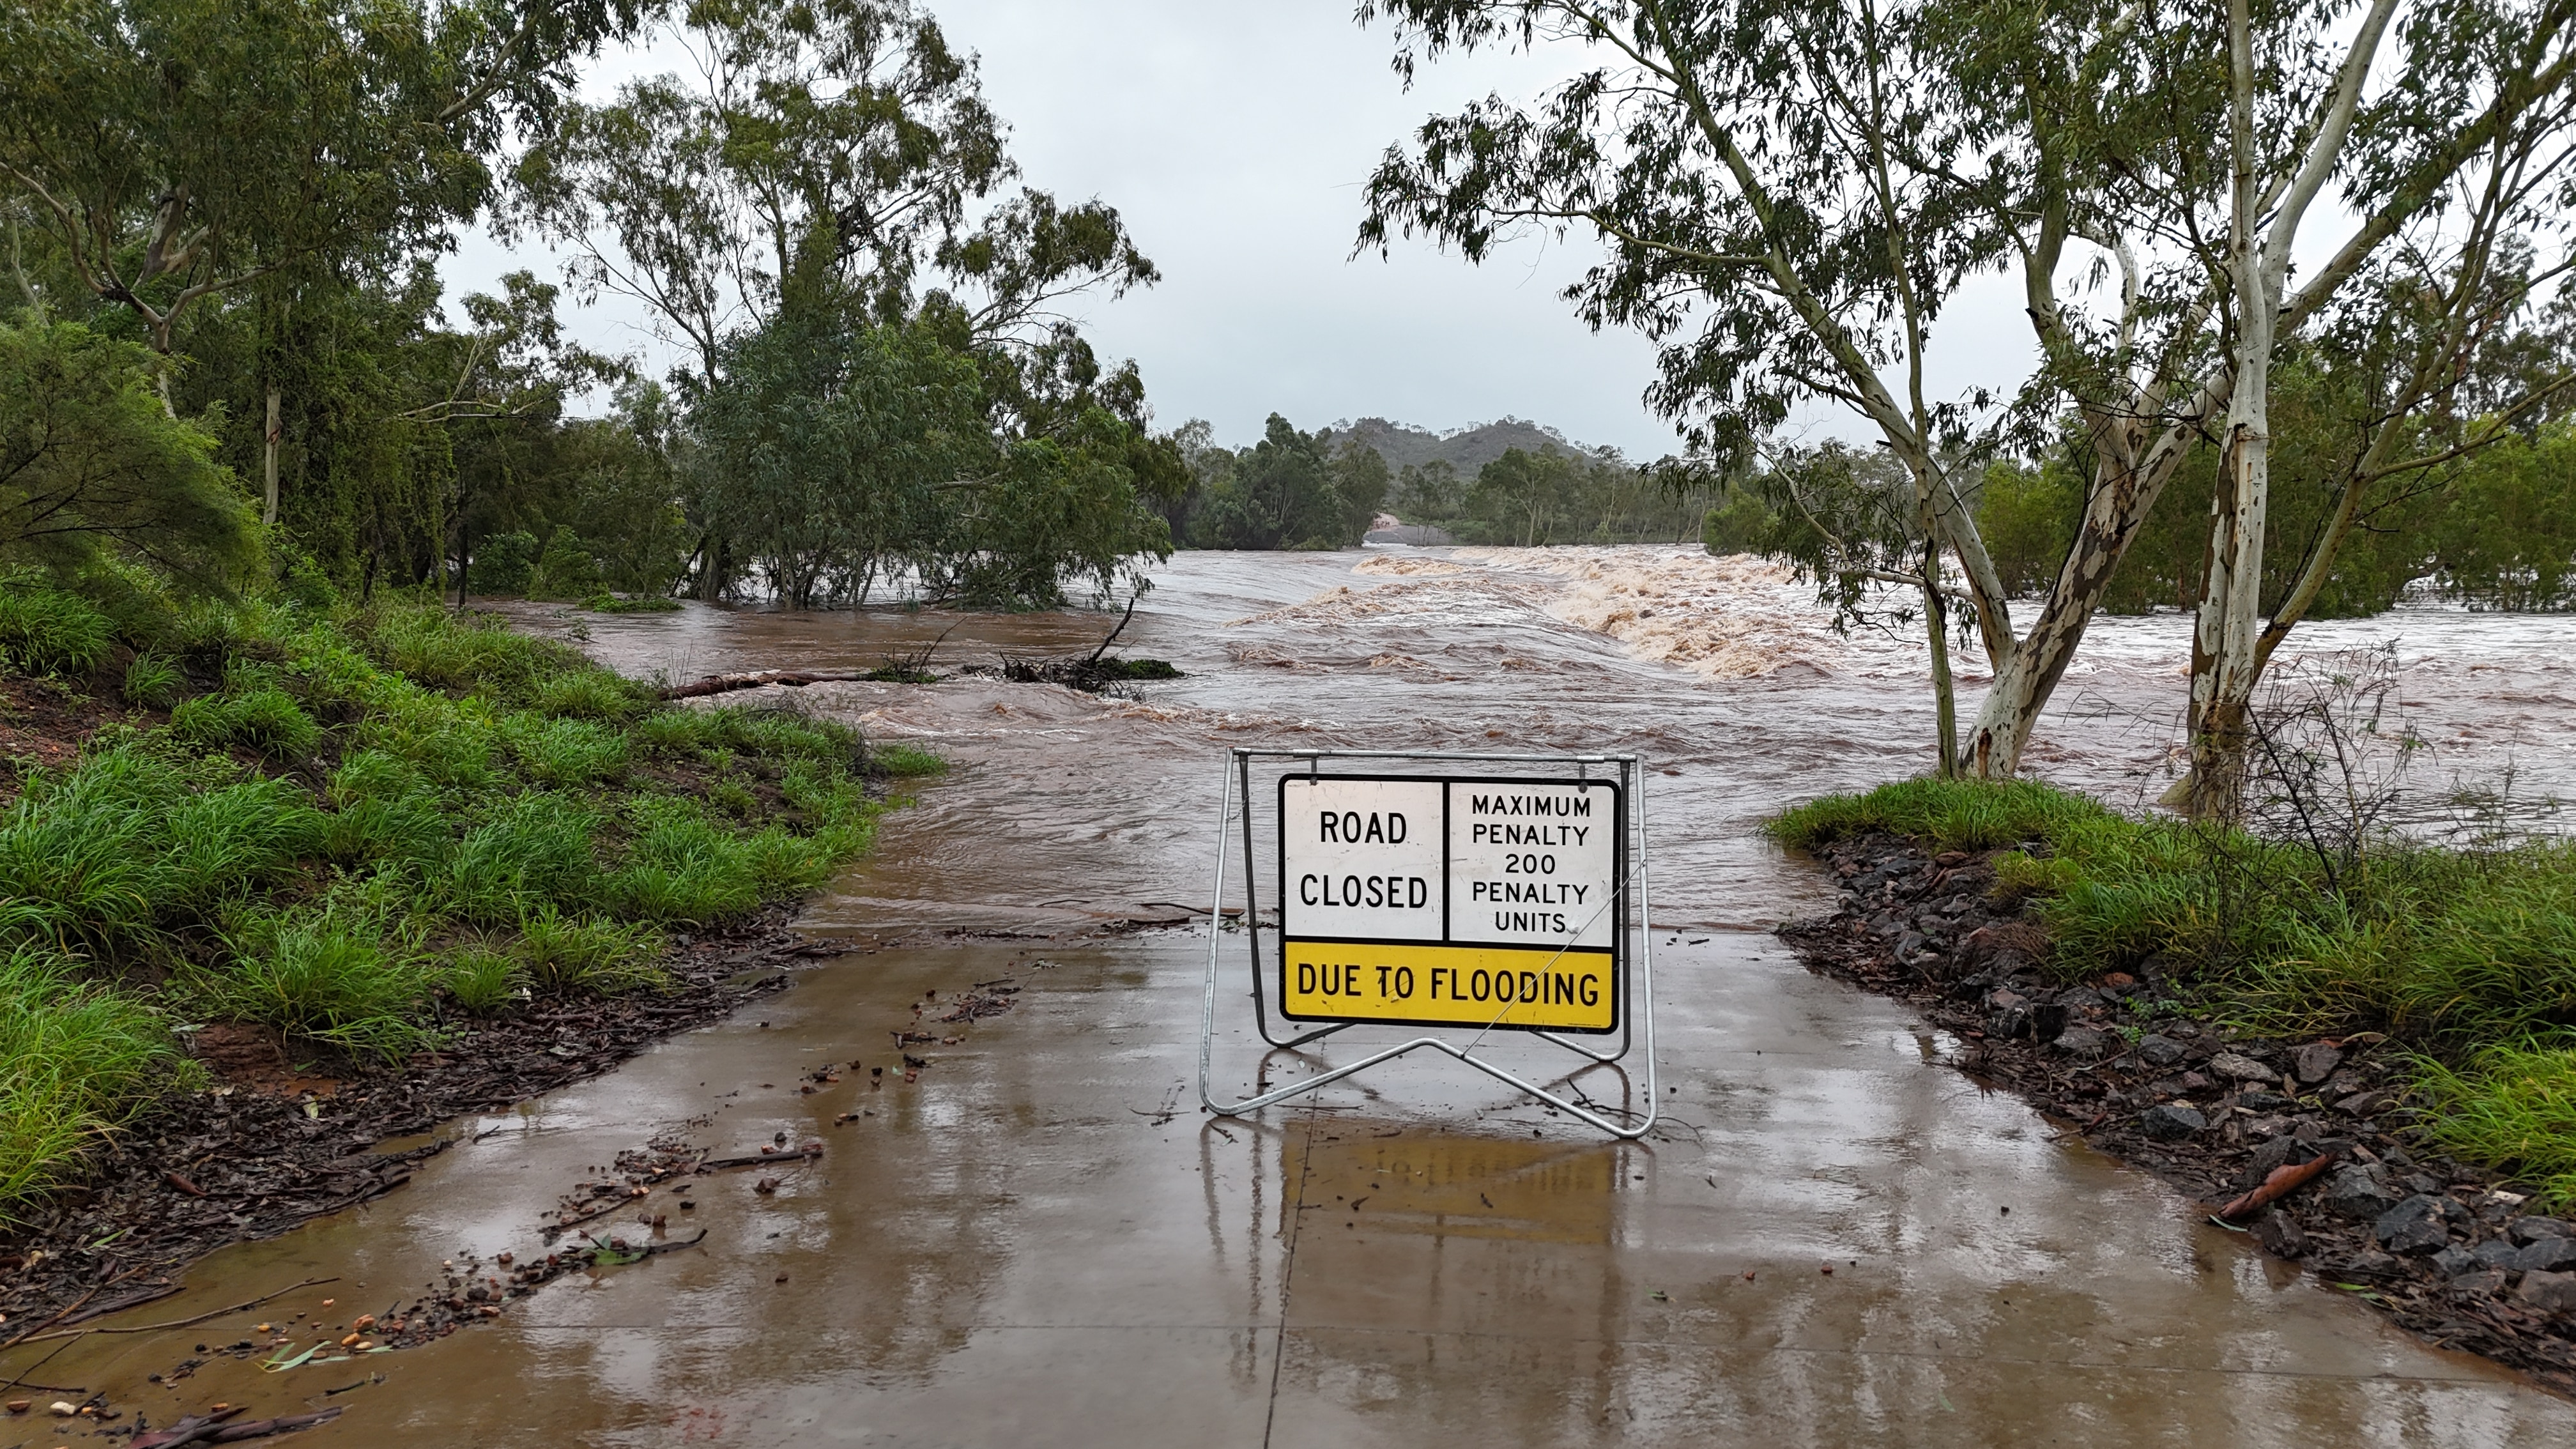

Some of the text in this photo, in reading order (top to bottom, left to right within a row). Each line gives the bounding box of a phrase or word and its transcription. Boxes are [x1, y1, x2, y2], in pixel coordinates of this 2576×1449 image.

[1473, 795, 1590, 817] MAXIMUM
[1321, 811, 1407, 844] ROAD
[1473, 824, 1590, 847] PENALTY
[1505, 854, 1556, 875] 200
[1300, 873, 1427, 908] CLOSED
[1473, 881, 1589, 905] PENALTY
[1495, 911, 1566, 933] UNITS
[1298, 963, 1598, 1007] DUE TO FLOODING
